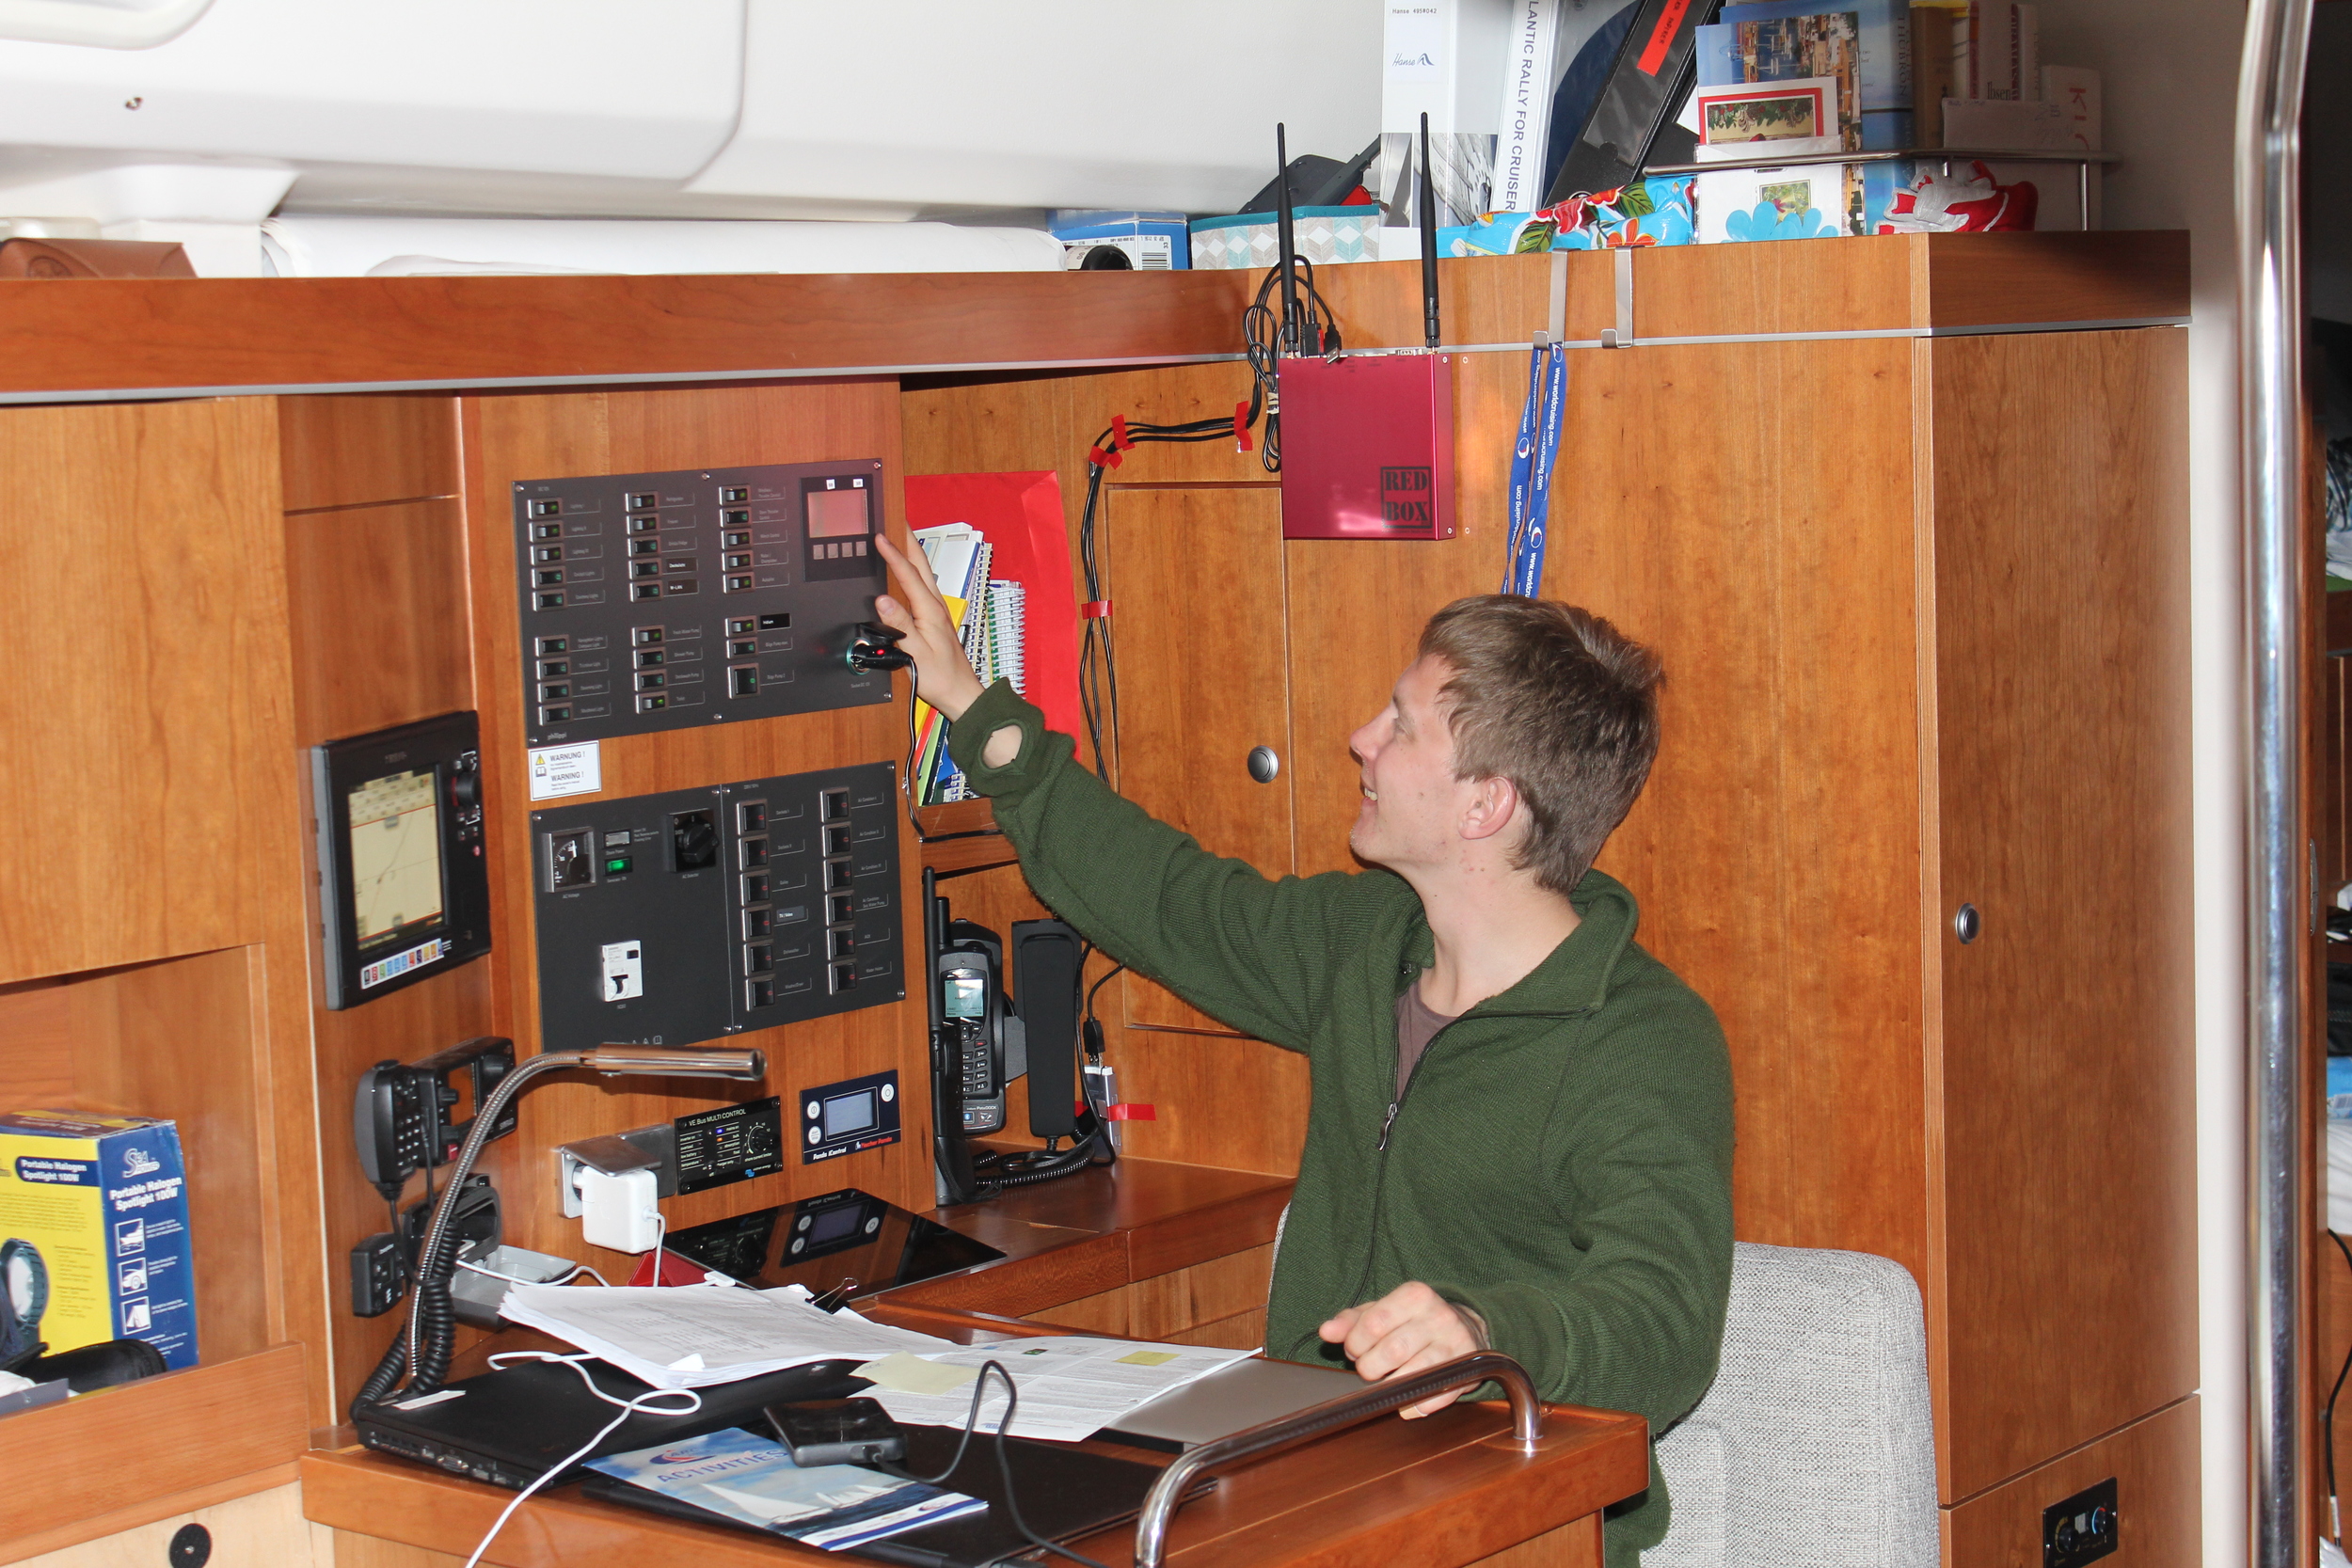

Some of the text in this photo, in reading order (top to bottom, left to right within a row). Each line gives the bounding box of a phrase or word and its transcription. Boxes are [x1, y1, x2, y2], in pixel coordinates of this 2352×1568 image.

[1392, 53, 1416, 67] Hanse
[1898, 17, 1908, 96] THUBRON
[1518, 58, 1533, 107] RALLY
[1987, 81, 2012, 100] Ibsen
[1513, 110, 1527, 141] FOR
[1548, 367, 1560, 446] www.worldcruising.com
[1385, 471, 1427, 491] RED
[1386, 501, 1428, 521] BOX
[549, 752, 581, 762] WARNUNG
[550, 772, 580, 782] WARNING
[689, 1109, 747, 1127] VE.Bus MULTI CONTROL
[878, 1136, 893, 1145] Panda
[813, 1146, 847, 1161] Panda iControl
[21, 1159, 87, 1173] Portable Halogen
[22, 1170, 57, 1181] Spotlight
[57, 1173, 80, 1182] 100W
[109, 1177, 183, 1201] Portable Halogen
[115, 1186, 179, 1212] Spotlight 100W
[657, 1449, 789, 1483] ACTIVITIES
